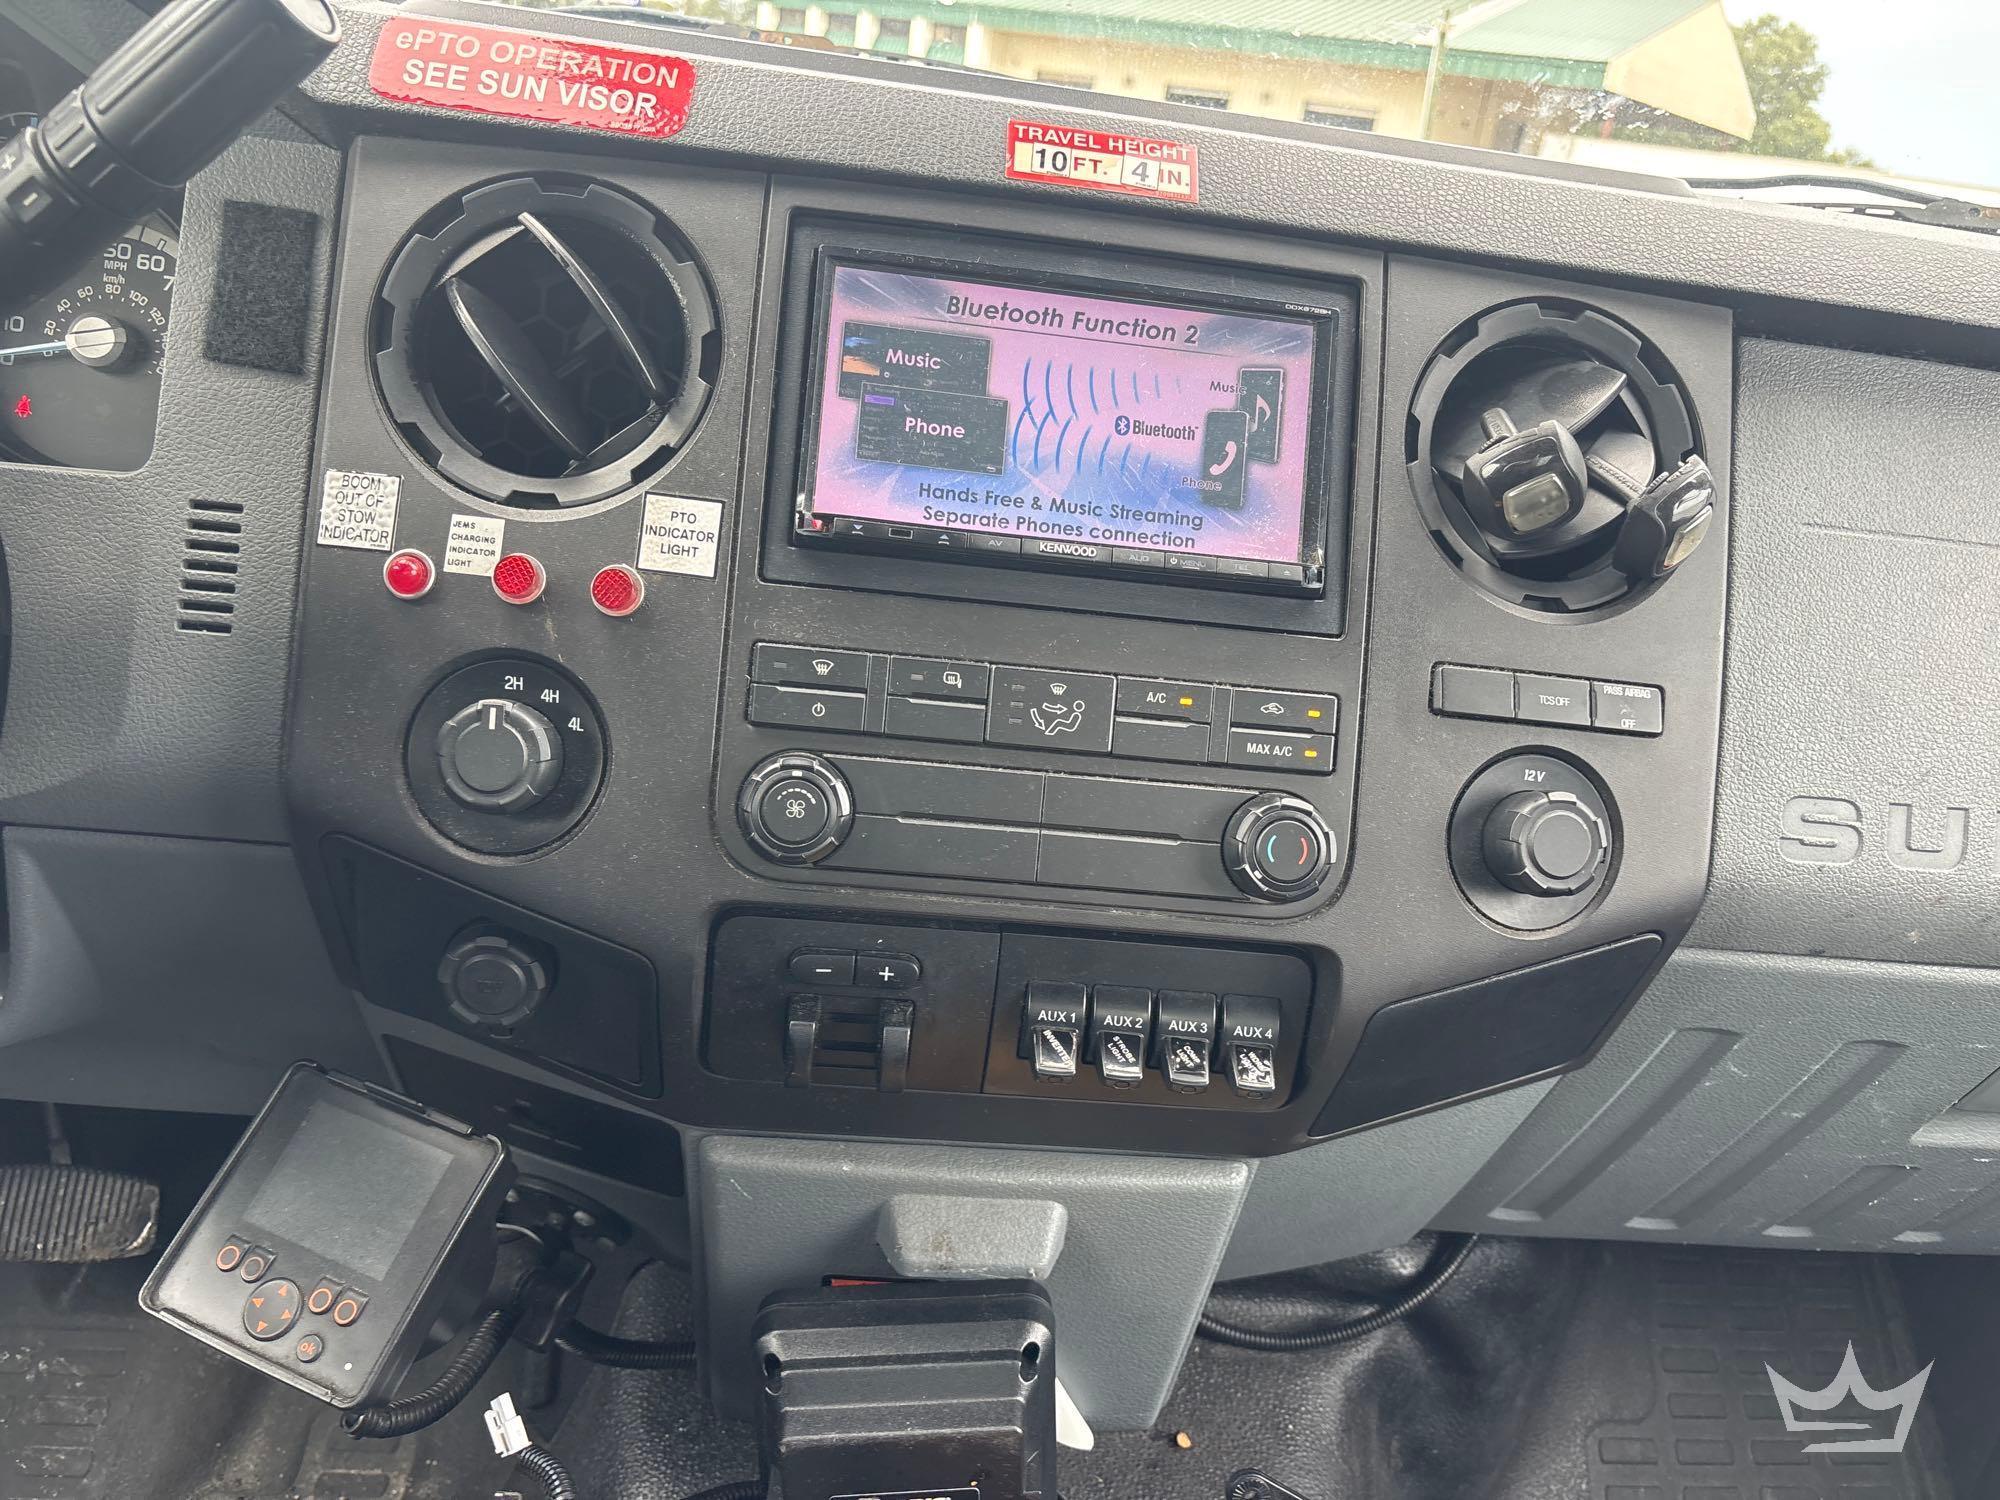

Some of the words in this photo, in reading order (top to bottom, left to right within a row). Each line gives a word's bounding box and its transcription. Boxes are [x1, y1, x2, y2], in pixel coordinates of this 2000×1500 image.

[395, 29, 481, 59] ePTO
[490, 40, 679, 89] OPERATION
[402, 59, 468, 92] SEE
[477, 70, 549, 103] SUN
[558, 80, 658, 119] VISOR
[1014, 125, 1101, 149] TRAVEL
[1108, 137, 1190, 161] HEIGHT
[1035, 149, 1067, 172] 10
[1073, 157, 1108, 175] FT.
[1131, 162, 1149, 182] 4
[1159, 168, 1190, 187] IN.
[104, 260, 128, 271] MPH
[136, 254, 165, 272] 60
[102, 273, 126, 284] km/h
[77, 286, 94, 299] 60
[105, 284, 121, 294] 80
[129, 290, 149, 306] 100
[57, 299, 71, 313] 40
[149, 307, 166, 325] 120
[946, 295, 1064, 328] Bluetooth
[1072, 311, 1177, 342] Function
[1184, 325, 1199, 344] 2
[44, 320, 57, 336] 20
[885, 348, 941, 369] Music
[1209, 381, 1248, 395] Music
[905, 417, 965, 438] Phone
[1132, 420, 1196, 441] Bluetooth
[342, 474, 381, 490] BOOM
[1181, 477, 1222, 491] Phone
[335, 491, 363, 506] OUT
[366, 494, 384, 507] OF
[919, 482, 978, 503] Hands
[984, 490, 1025, 508] Free
[1030, 496, 1042, 510] &
[1049, 498, 1103, 517] Music
[1109, 504, 1204, 531] Streaming
[338, 509, 377, 524] STOW
[670, 511, 697, 524] PTO
[453, 521, 476, 529] JEMS
[923, 505, 1010, 529] Separate
[1016, 515, 1083, 537] Phones
[1089, 526, 1196, 549] connection
[320, 524, 389, 544] INDICATOR
[451, 533, 496, 544] CHARGING
[645, 524, 715, 543] INDICATOR
[449, 546, 496, 557] INDICATOR
[660, 543, 699, 557] LIGHT
[1039, 542, 1098, 558] KENWOOD
[447, 559, 472, 567] LIGHT
[504, 675, 524, 691] 2H
[540, 688, 560, 703] 4H
[1146, 692, 1167, 704] A/C
[1603, 685, 1624, 696] PASS
[1624, 687, 1652, 699] AIRBAG
[1538, 694, 1555, 706] TCS
[1555, 696, 1571, 706] OFF
[567, 717, 584, 732] 4L
[1621, 718, 1637, 729] OFF
[1247, 742, 1271, 755] MAX
[1272, 745, 1293, 757] A/C
[1523, 768, 1546, 783] 12V
[1779, 795, 2000, 872] SU
[1037, 1009, 1068, 1024] AUX
[1071, 1012, 1077, 1023] 1
[1103, 1014, 1134, 1028] AUX
[1134, 1017, 1143, 1029] 2
[1168, 1020, 1197, 1033] AUX
[1199, 1022, 1208, 1034] 3
[1233, 1025, 1262, 1038] AUX
[1264, 1028, 1273, 1039] 4
[1043, 1029, 1074, 1066] INVERTER
[1107, 1042, 1126, 1063] LIGHT
[1112, 1035, 1136, 1063] STROBE
